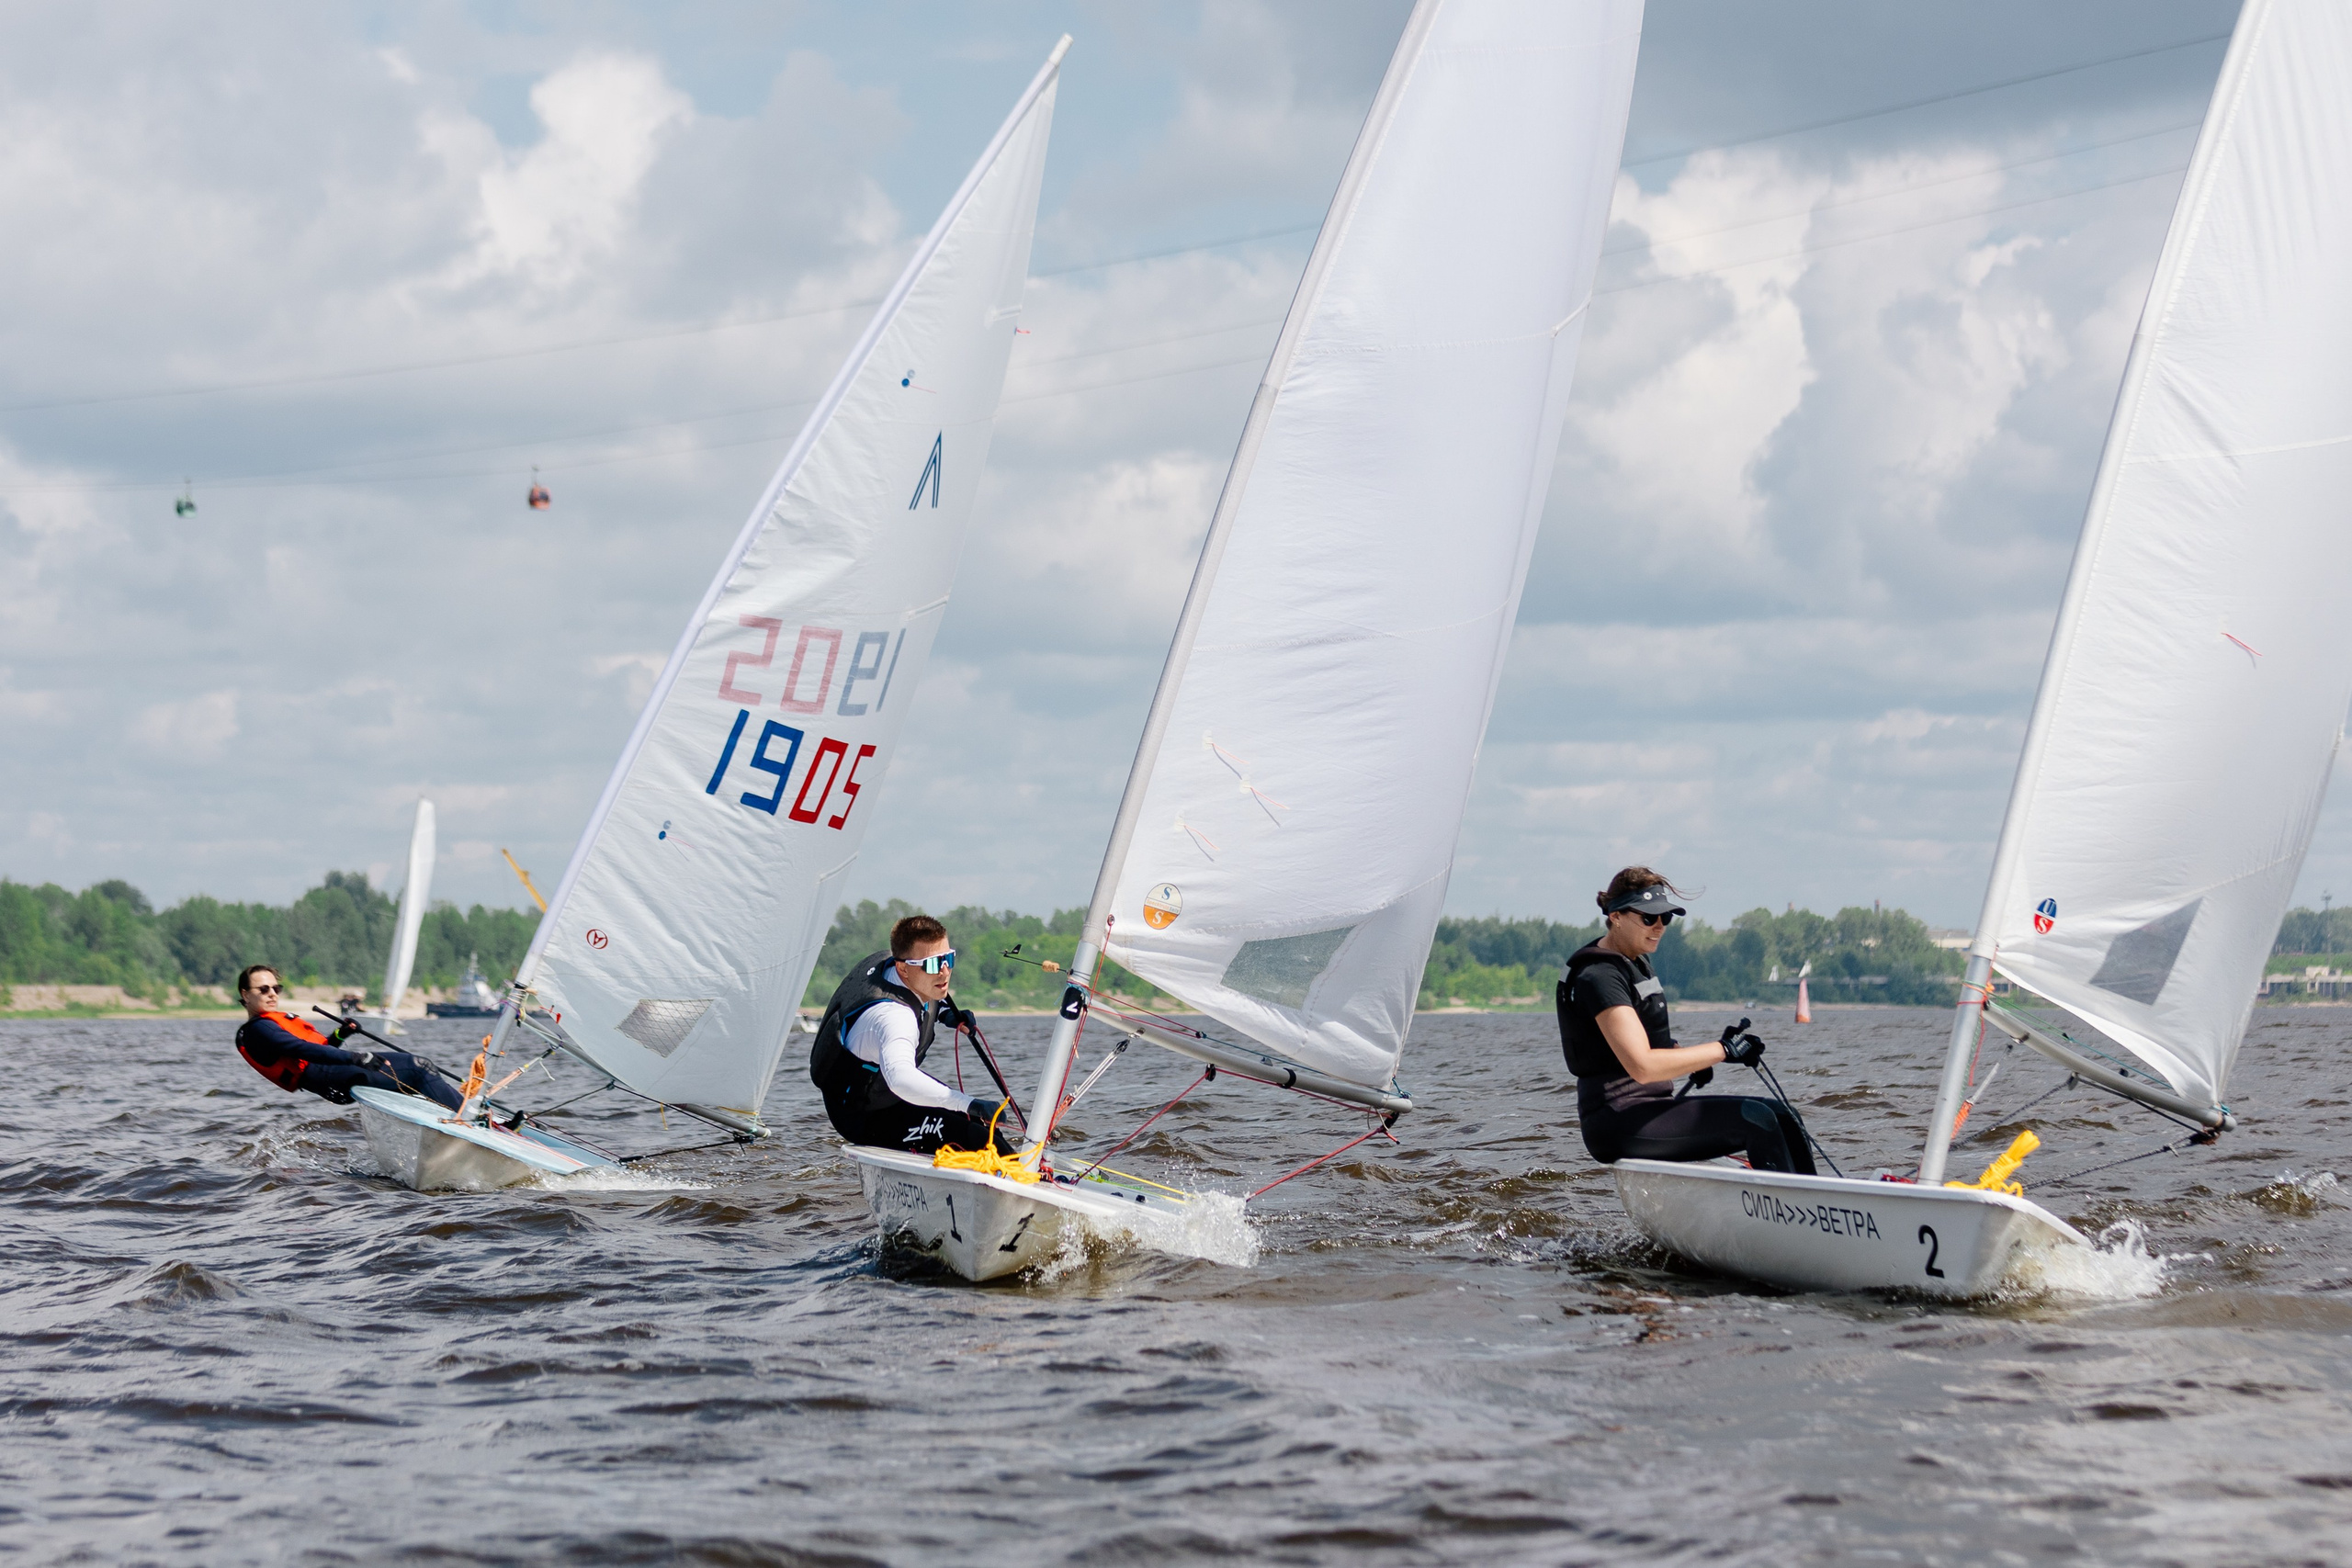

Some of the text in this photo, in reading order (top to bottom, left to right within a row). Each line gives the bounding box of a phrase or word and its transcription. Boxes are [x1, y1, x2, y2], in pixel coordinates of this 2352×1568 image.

[706, 708, 876, 830] 1905
[1152, 910, 1164, 925] S
[1161, 886, 1172, 900] S
[946, 1193, 962, 1244] 1
[1917, 1224, 1945, 1279] 2
